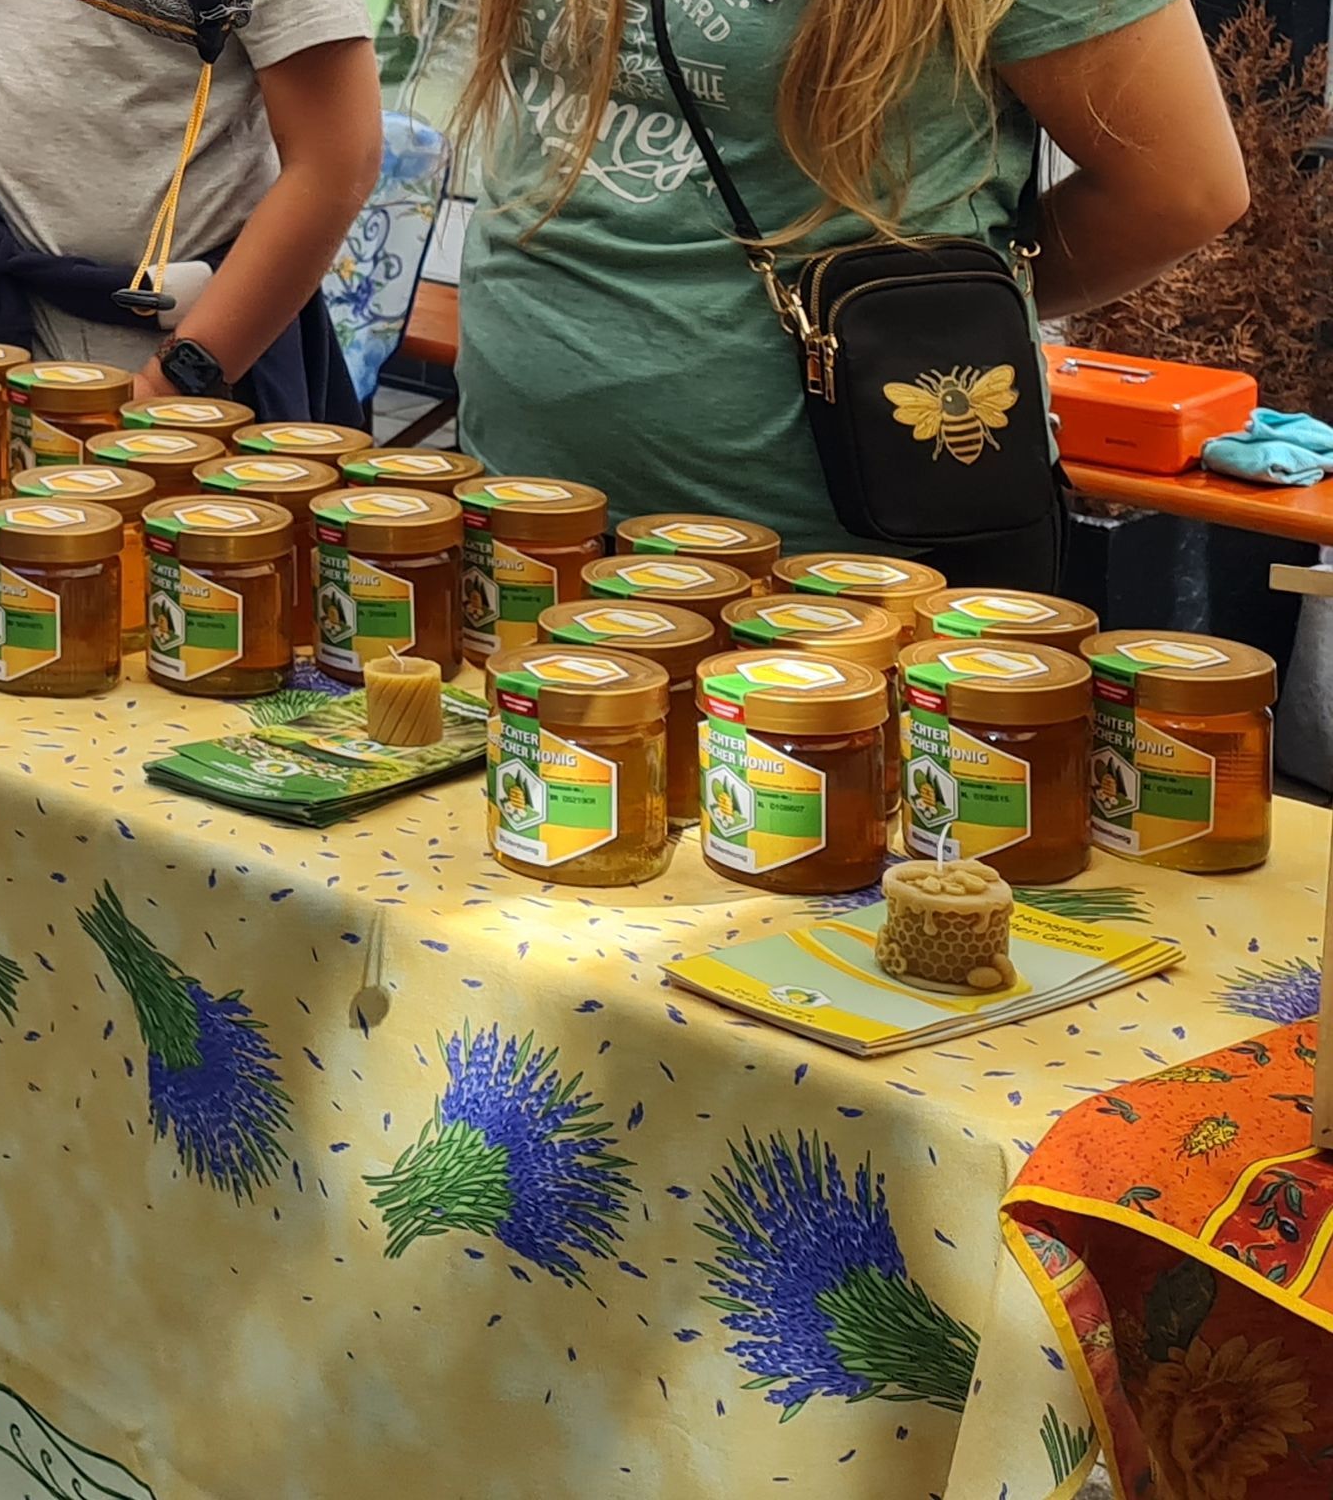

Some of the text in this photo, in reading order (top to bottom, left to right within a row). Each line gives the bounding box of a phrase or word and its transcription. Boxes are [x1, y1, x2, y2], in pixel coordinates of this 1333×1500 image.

[530, 747, 577, 768] HONIG
[941, 745, 989, 765] HONIG
[1125, 737, 1175, 758] HONIG
[738, 754, 785, 775] HONIG
